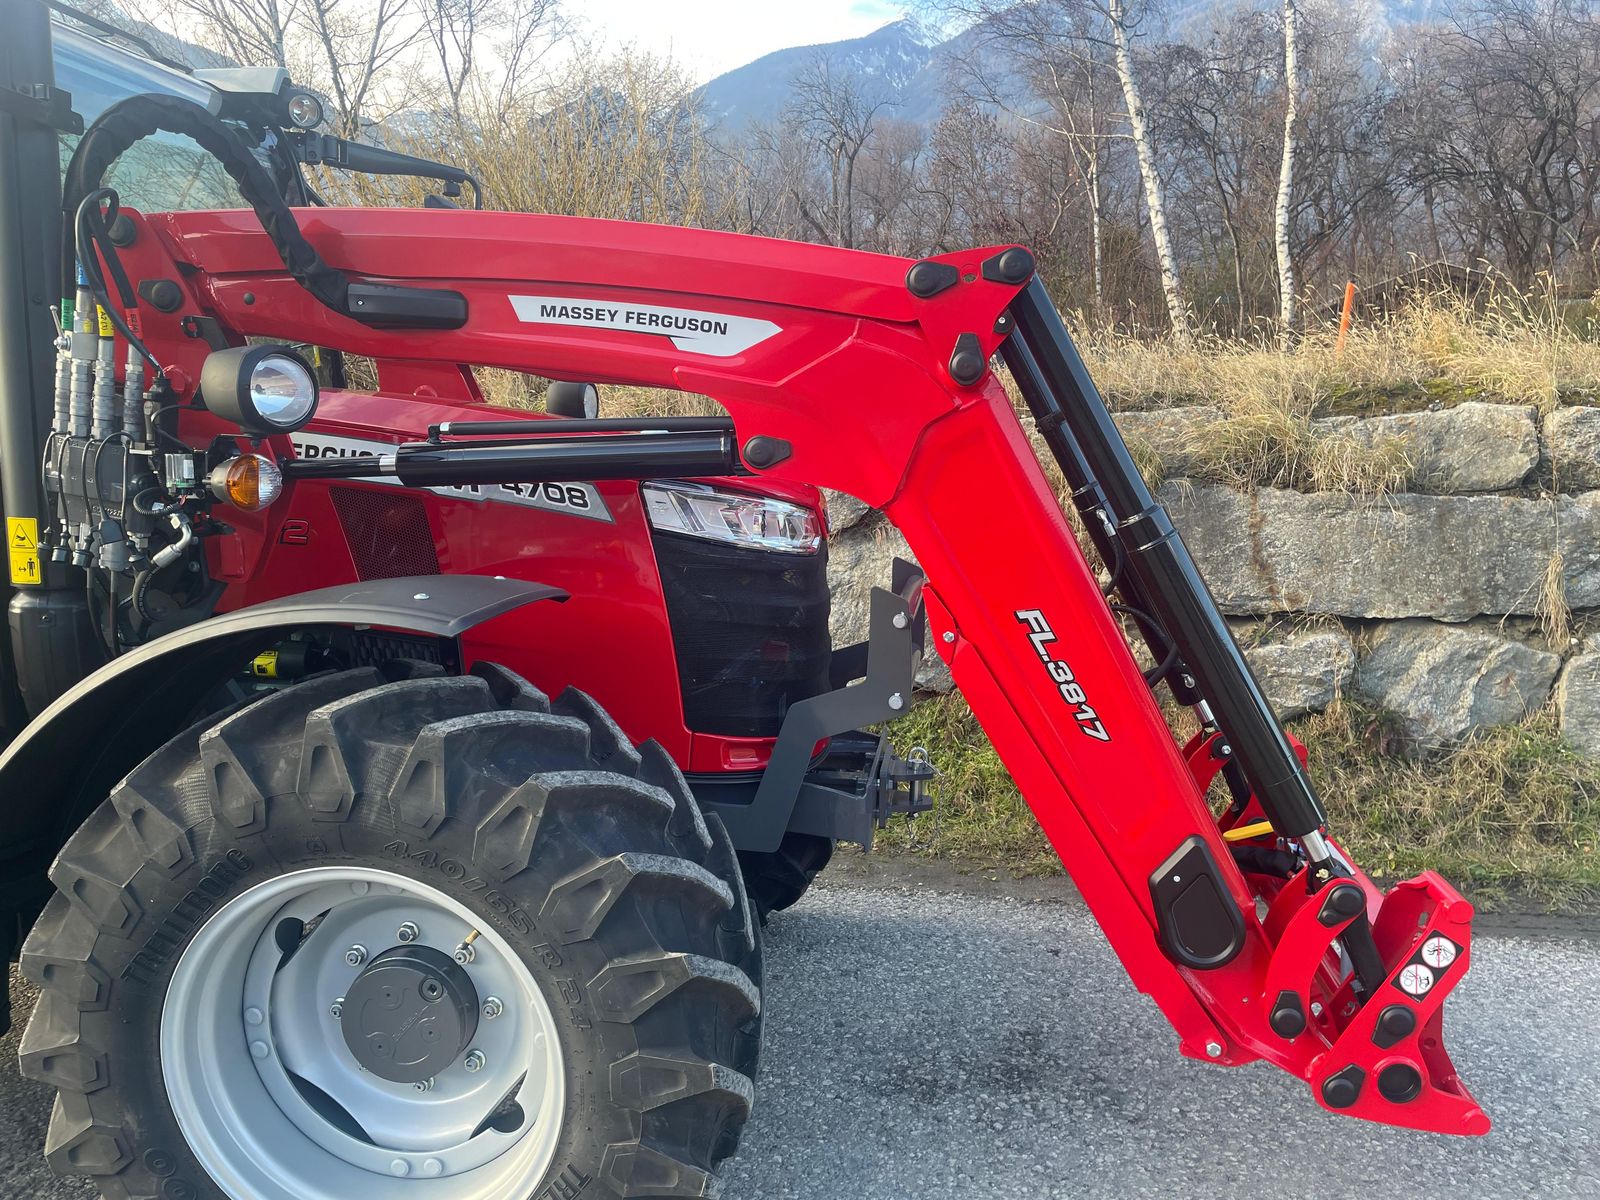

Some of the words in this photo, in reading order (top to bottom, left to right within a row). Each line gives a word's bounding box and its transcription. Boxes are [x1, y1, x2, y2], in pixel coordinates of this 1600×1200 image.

[540, 304, 619, 323] MASSEY
[625, 310, 728, 335] FERGUSON
[1014, 608, 1113, 742] FL.3817
[119, 847, 253, 986] TRELLEBORG
